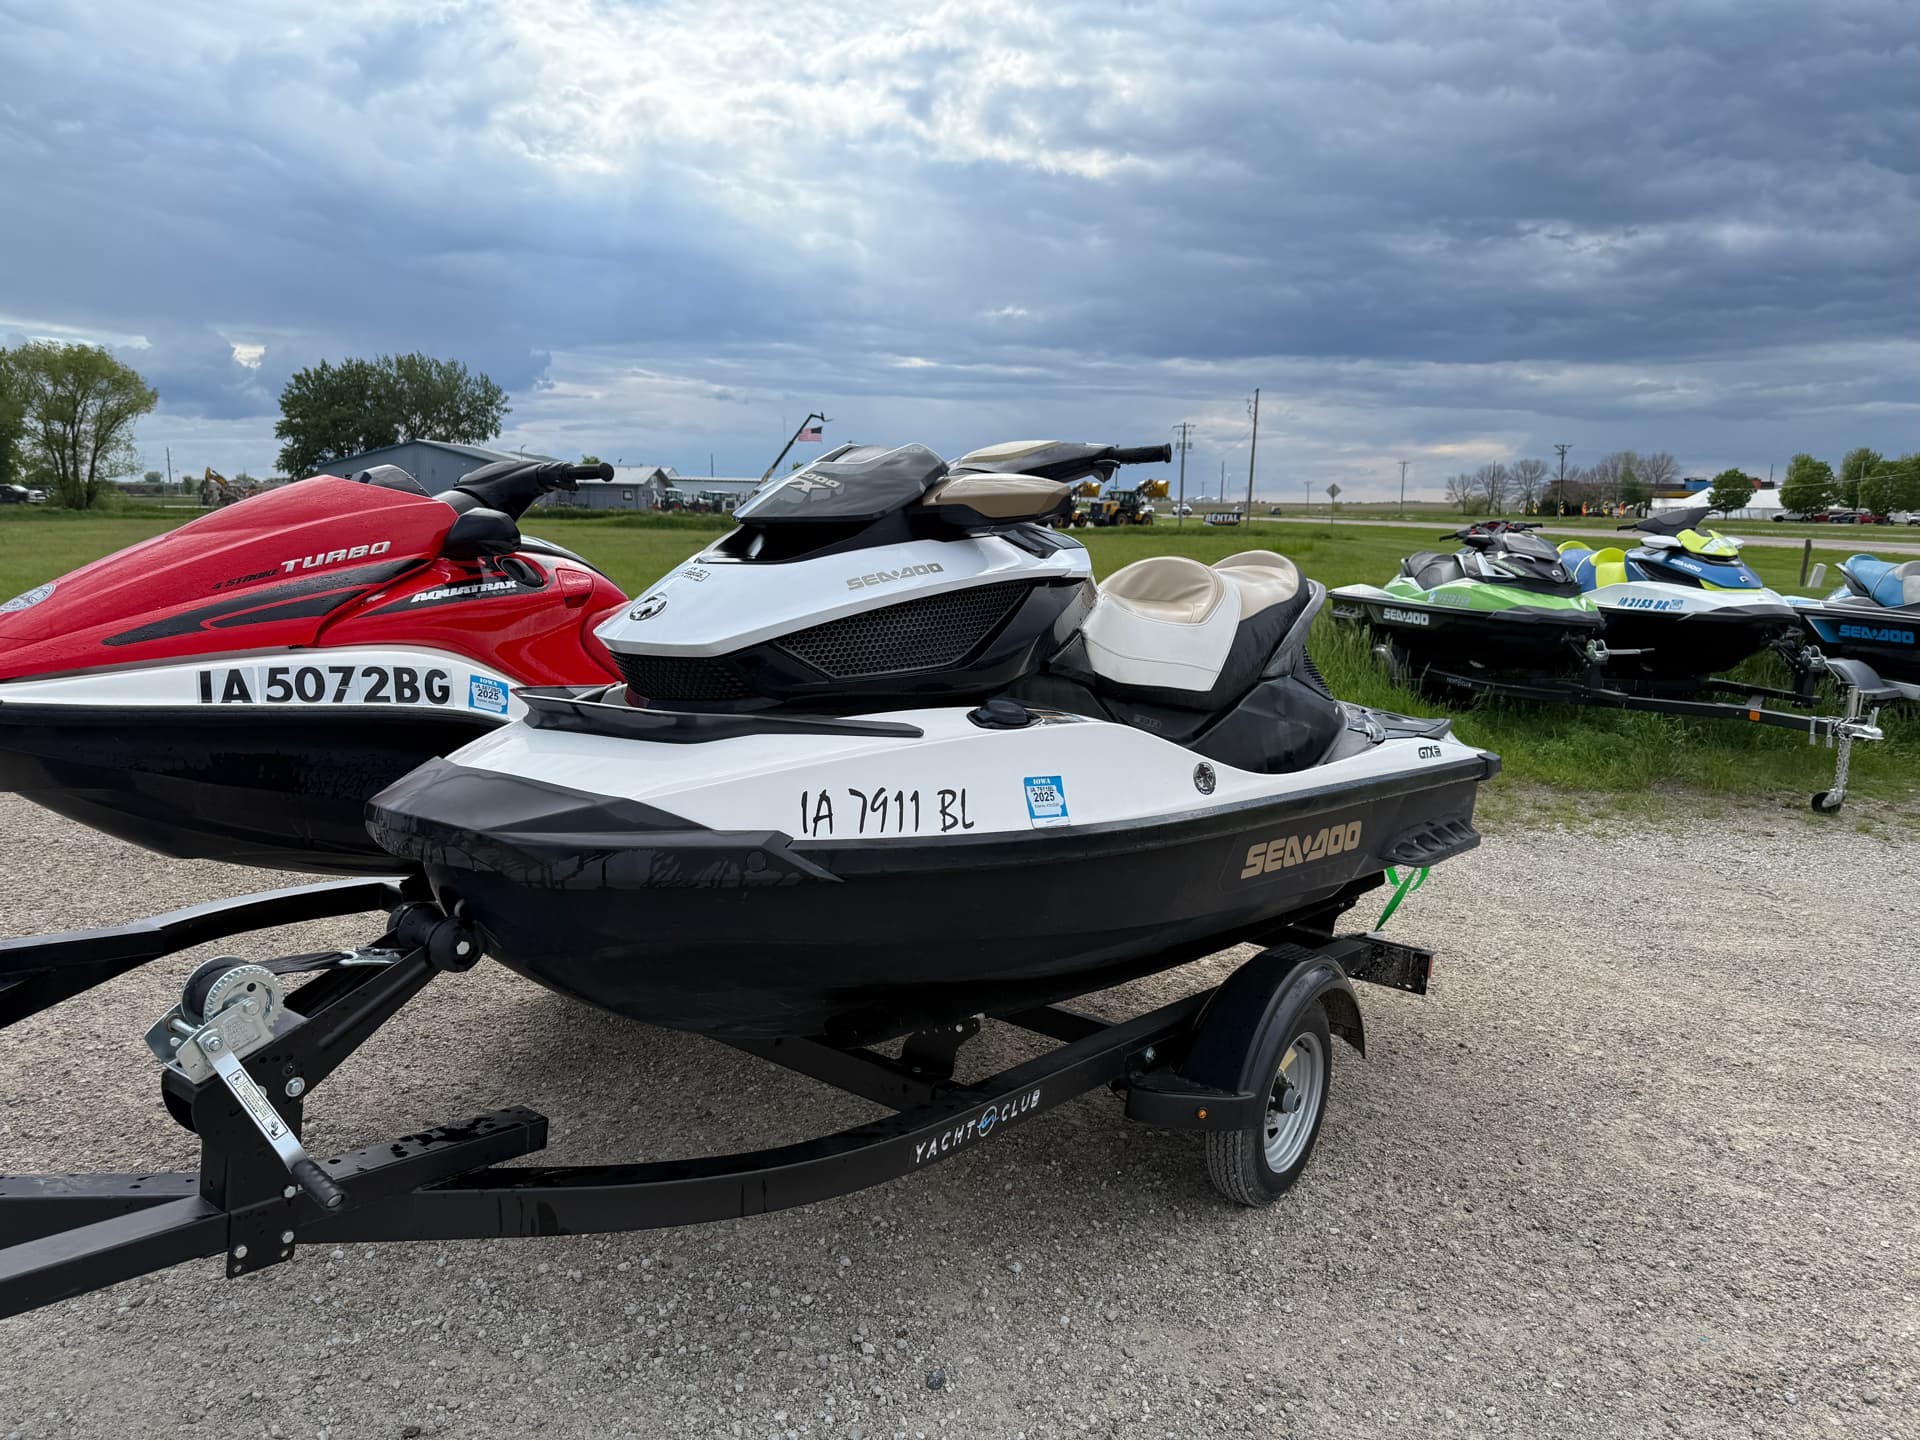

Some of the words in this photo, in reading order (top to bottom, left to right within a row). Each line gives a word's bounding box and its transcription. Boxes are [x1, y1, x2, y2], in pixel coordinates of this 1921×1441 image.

[1205, 513, 1240, 523] RENTAL
[281, 541, 391, 573] TURBO
[410, 580, 518, 603] AQUATRAX
[199, 668, 254, 704] IA
[265, 666, 451, 705] 5072BG
[480, 677, 498, 687] IOWA
[477, 688, 499, 701] 2025
[1418, 745, 1435, 759] GTX
[1033, 791, 1055, 802] 2025
[801, 789, 834, 838] IA
[848, 787, 920, 834] 7911
[936, 788, 975, 833] BL
[916, 1119, 977, 1164] YACHT
[1001, 1089, 1041, 1122] CLUB
